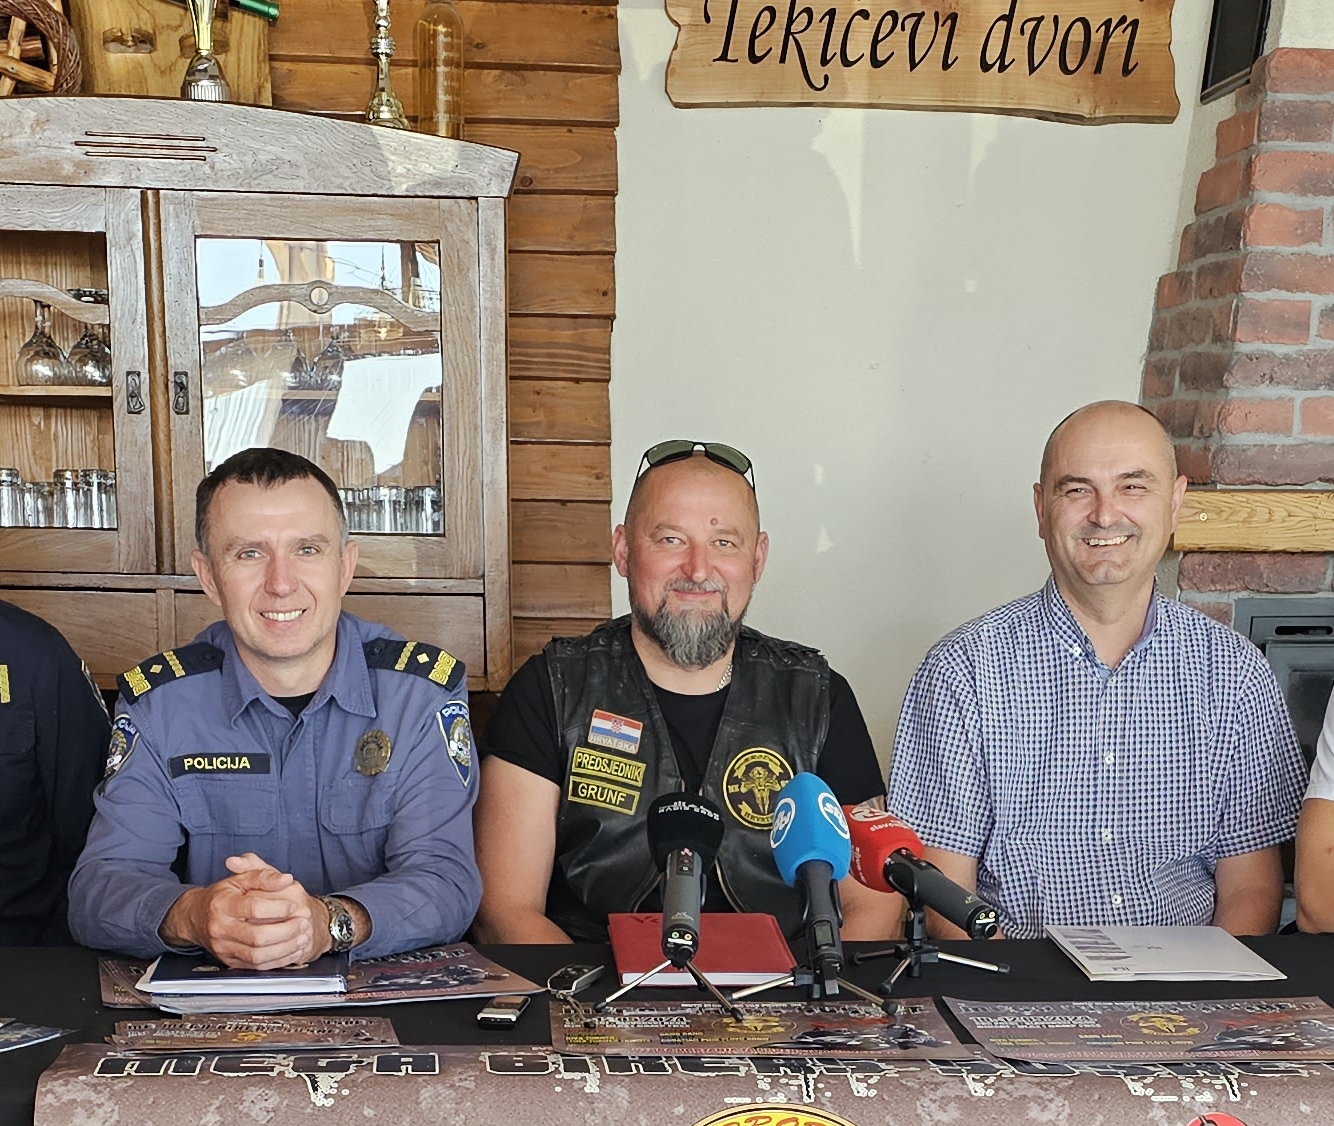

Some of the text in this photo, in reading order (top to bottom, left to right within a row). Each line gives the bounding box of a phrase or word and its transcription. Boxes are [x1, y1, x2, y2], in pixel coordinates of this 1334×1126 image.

[184, 756, 250, 771] POLICIJA
[577, 752, 641, 783] PREDSJEDNIK
[578, 782, 627, 805] GRUNF
